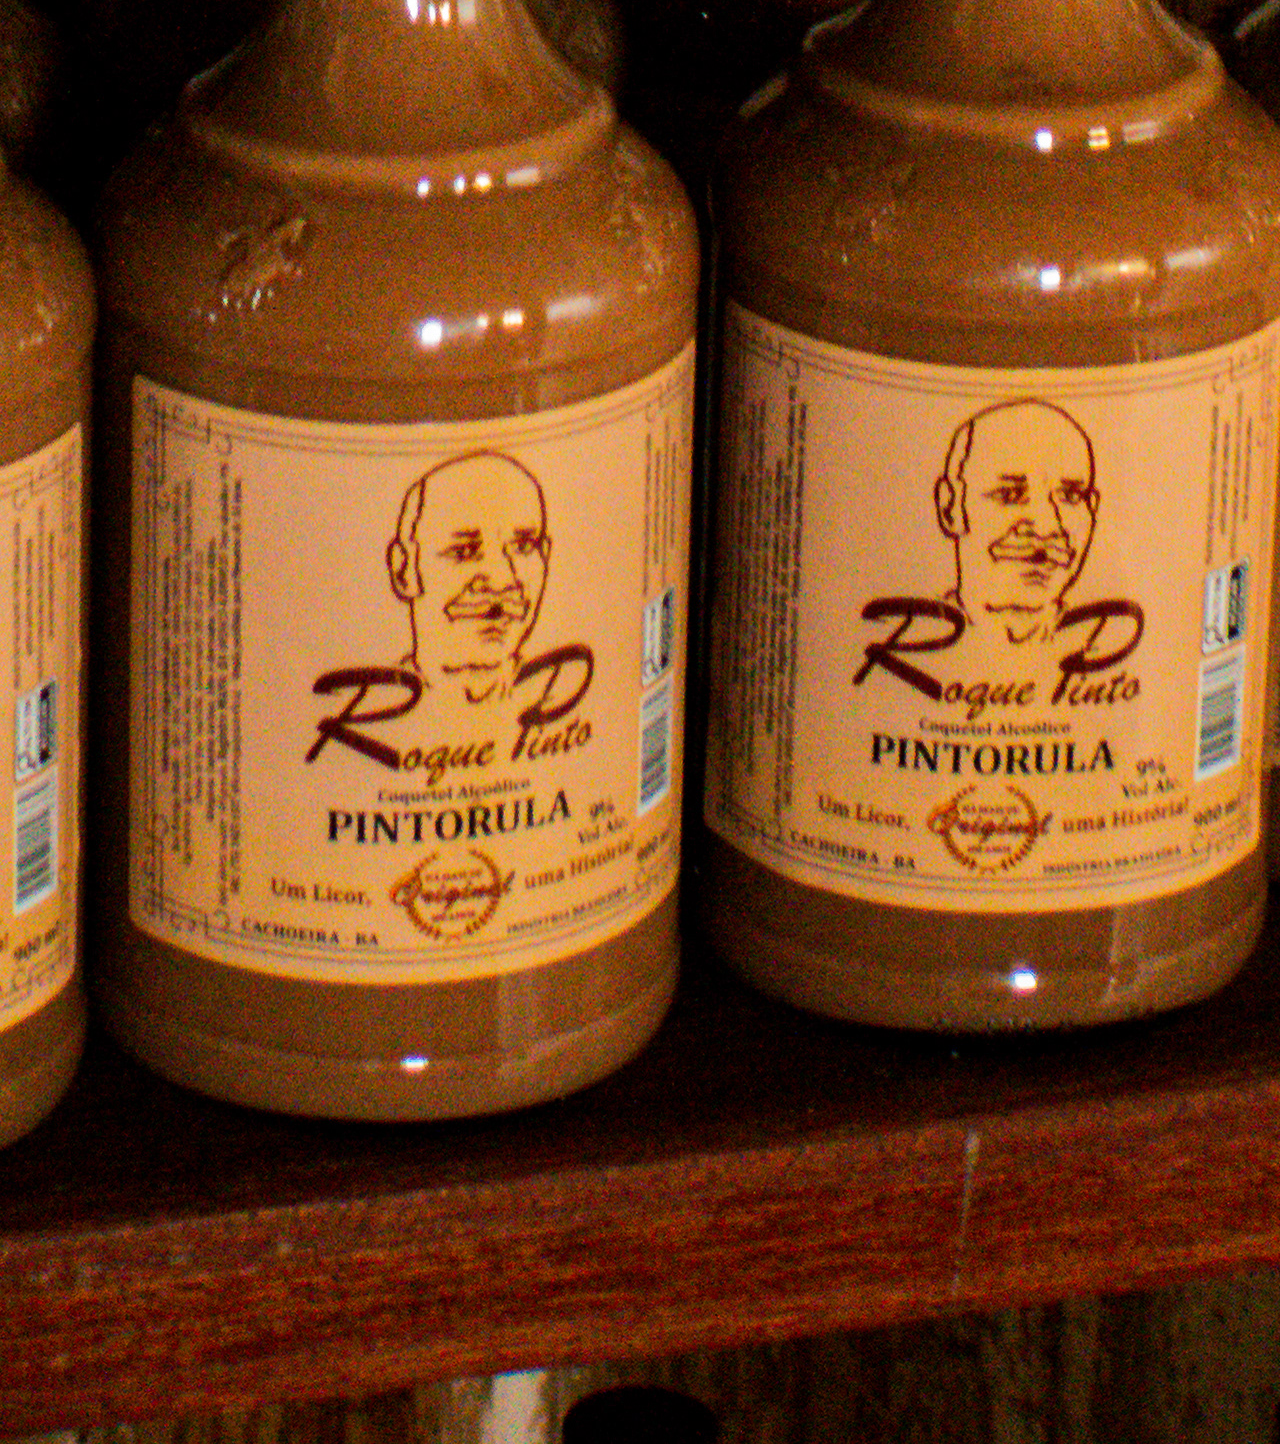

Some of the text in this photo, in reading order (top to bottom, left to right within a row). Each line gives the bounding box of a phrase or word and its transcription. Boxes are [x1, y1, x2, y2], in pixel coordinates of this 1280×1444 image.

[853, 597, 1144, 720] Roque Pinto
[305, 643, 594, 786] Roque Pinto
[997, 721, 1071, 735] Alcoólico
[871, 733, 1114, 774] PINTORULA
[328, 789, 571, 845] PINTORULA
[817, 794, 1190, 834] Um Licor, uma História!
[790, 830, 916, 870] CACHOEIRA BA
[271, 877, 307, 898] Um
[313, 881, 371, 906] Licor,
[524, 867, 565, 890] uma
[242, 918, 378, 946] CACHOEIRA BA
